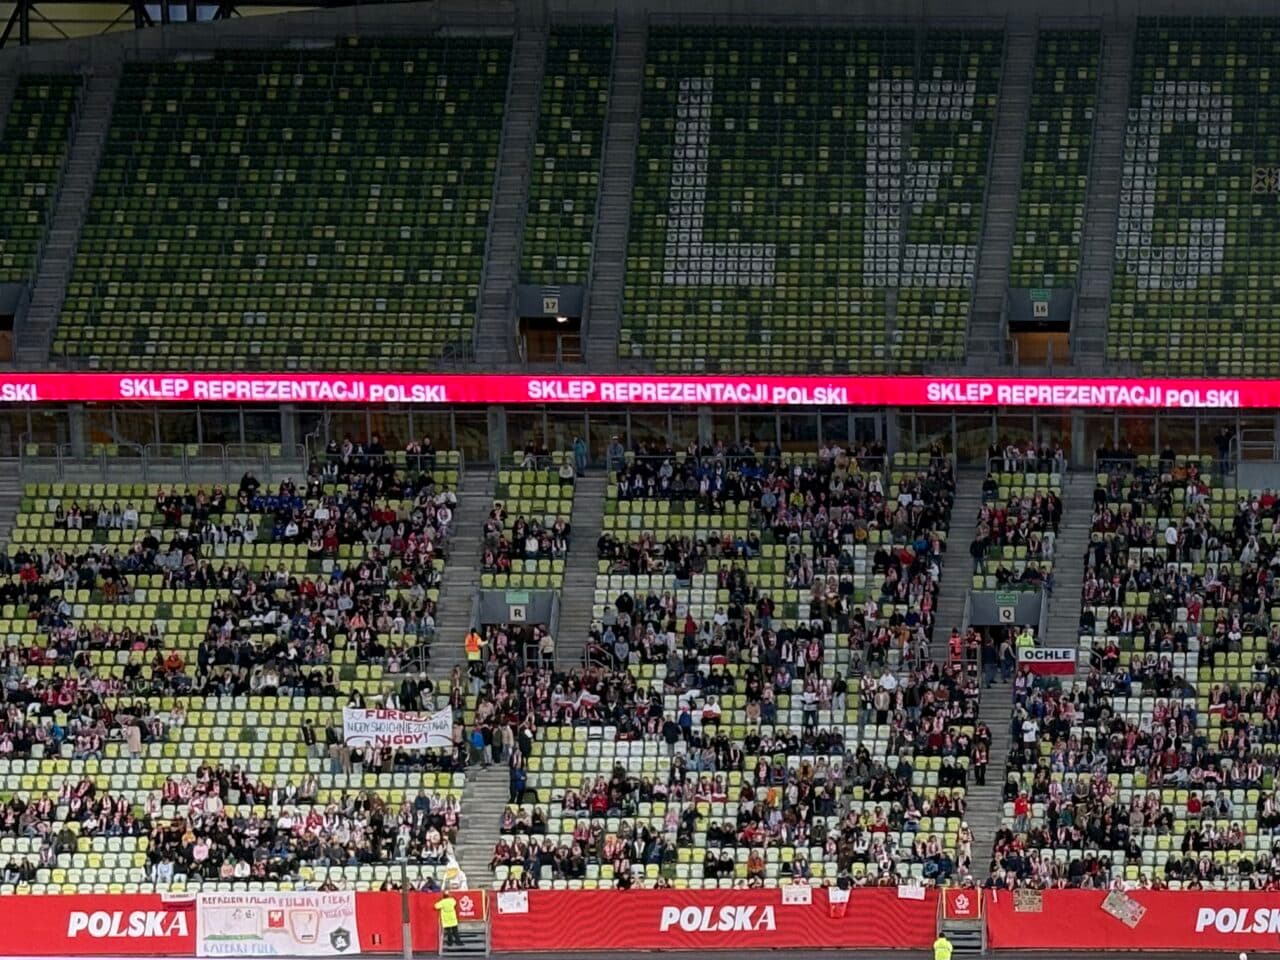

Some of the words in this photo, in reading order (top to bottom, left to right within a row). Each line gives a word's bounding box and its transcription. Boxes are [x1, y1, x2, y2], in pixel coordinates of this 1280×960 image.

[0, 383, 38, 402] SKI
[120, 379, 188, 399] SKLEP
[193, 381, 365, 401] REPREZENTACJI
[369, 384, 448, 403] POLSKI
[527, 381, 596, 402] SKLEP
[600, 383, 766, 404] REPREZENTACJI
[769, 386, 849, 405] POLSKI
[927, 383, 993, 402] SKLEP
[997, 385, 1162, 405] REPREZENTACJI
[1165, 389, 1240, 408] POLSKI
[1024, 649, 1071, 661] OCHLE
[68, 911, 189, 937] POLSKA
[659, 906, 777, 931] POLSKA
